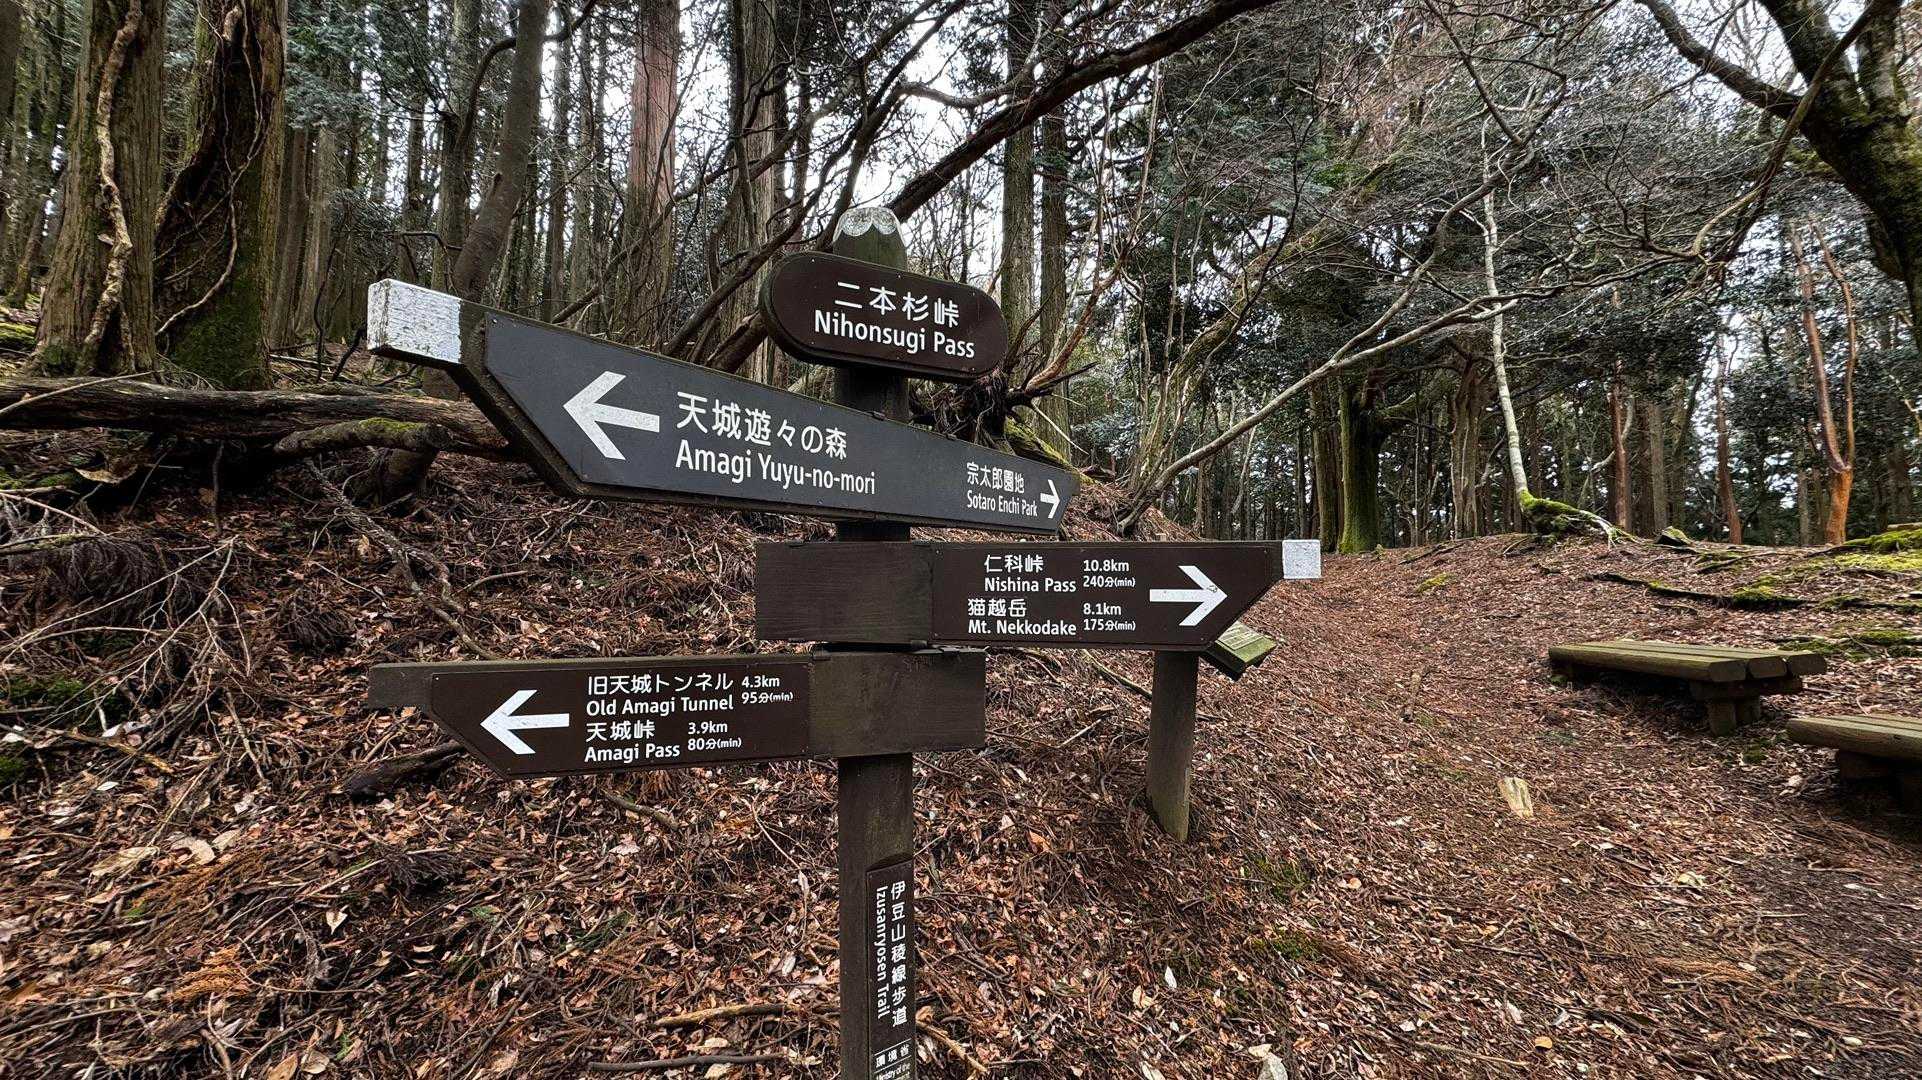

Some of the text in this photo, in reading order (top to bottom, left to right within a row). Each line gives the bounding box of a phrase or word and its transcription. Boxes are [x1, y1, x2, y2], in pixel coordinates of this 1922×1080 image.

[834, 281, 960, 328] 二本杉峠
[814, 309, 975, 358] Nihonsugi Pass
[676, 391, 847, 460] 天城遊々の森
[675, 439, 876, 495] Amagi Yuyu-no-mori
[966, 462, 1025, 494] 宗太郎園地
[966, 490, 1038, 517] Sotaro Enchi Park
[984, 554, 1130, 573] 仁科峠 10.8km
[984, 576, 1136, 592] Nishina Pass 240分(min)
[967, 598, 1122, 617] 猫越岳 8.1km
[968, 618, 1136, 636] Mt. Nekkodake 175分(min)
[588, 672, 780, 695] 旧天城トンネル 4.3km
[586, 692, 794, 717] Old Amagi Tunnel 95分(min)
[585, 720, 728, 742] 天城峠 3.9km
[584, 737, 742, 764] Amagi Pass 80分(min)
[874, 885, 891, 1019] Izusanryosen Trail
[890, 880, 908, 1027] 伊豆山稜線歩道
